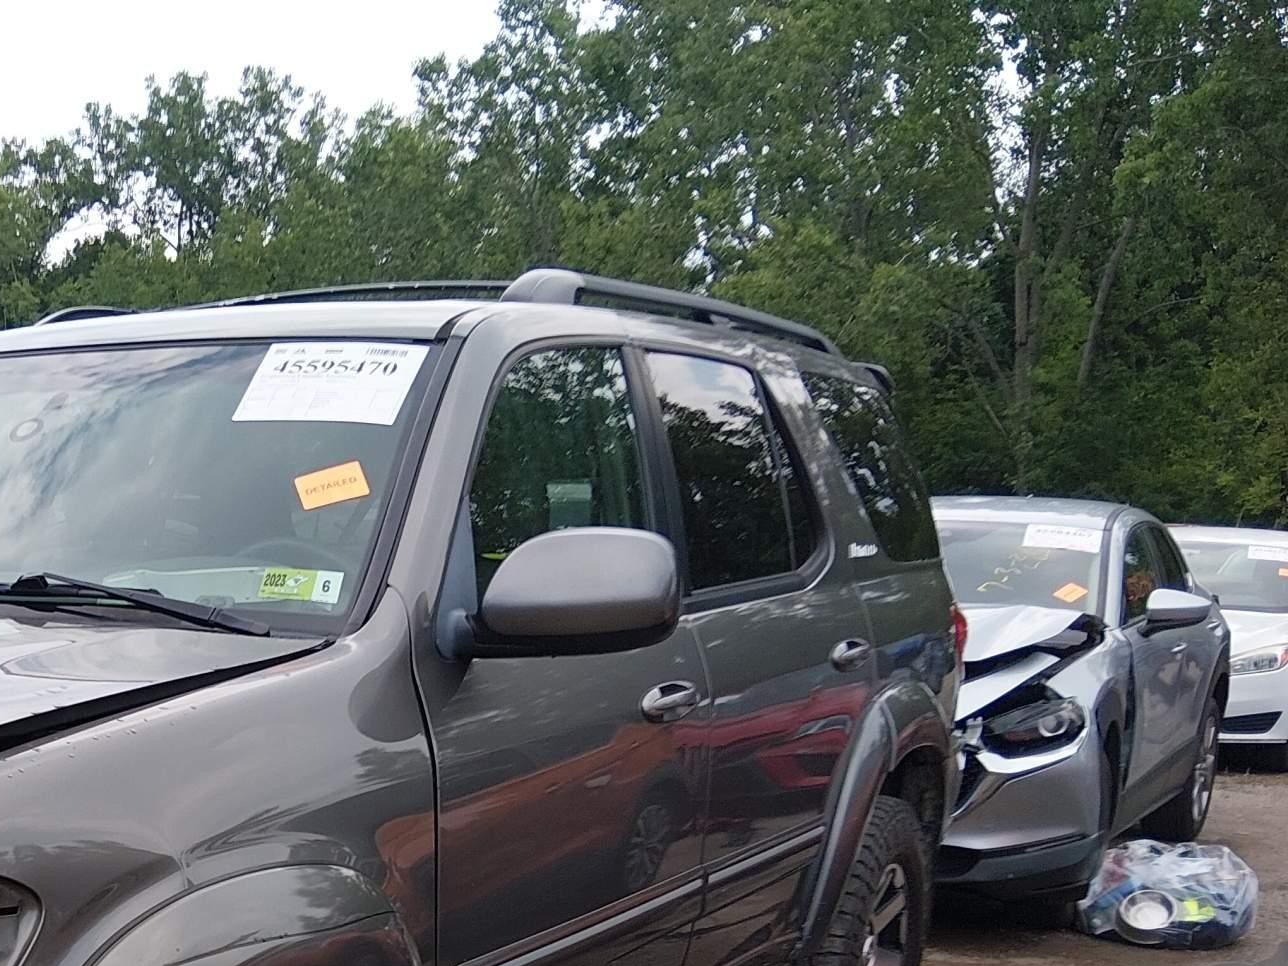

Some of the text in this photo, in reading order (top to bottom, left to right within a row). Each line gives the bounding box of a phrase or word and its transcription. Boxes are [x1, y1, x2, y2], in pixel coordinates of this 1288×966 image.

[274, 360, 398, 376] 45595470
[305, 476, 357, 496] DETAILED
[263, 573, 287, 587] 2023
[322, 580, 331, 593] 6
